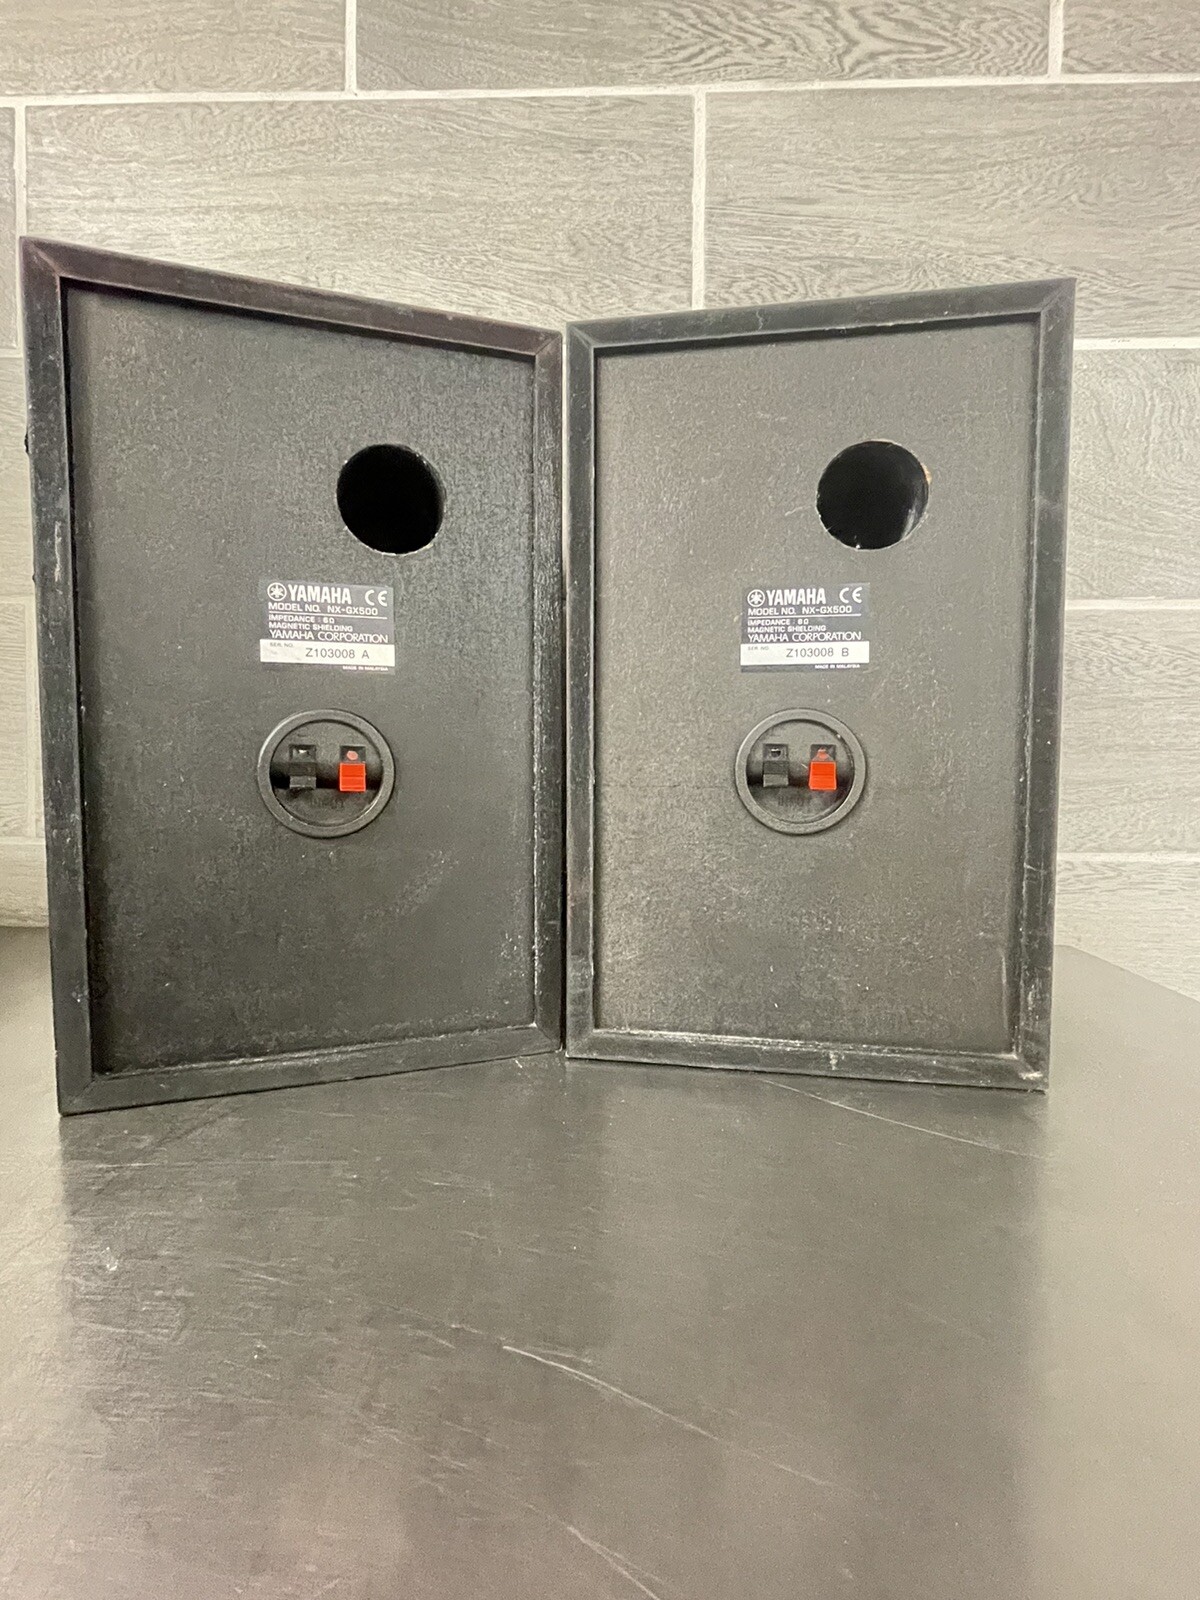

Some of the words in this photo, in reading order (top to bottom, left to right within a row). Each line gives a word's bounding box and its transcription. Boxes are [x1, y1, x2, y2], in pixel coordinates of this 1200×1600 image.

[289, 584, 351, 604] YAMAHA
[767, 588, 826, 606] YAMAHA
[268, 602, 303, 611] MODEL
[305, 604, 320, 612] NO.
[327, 605, 378, 615] NX-GX500
[748, 607, 778, 615] MODEL
[802, 606, 852, 614] NX-GX500
[269, 614, 315, 622] IMPEDANCE
[269, 622, 310, 630] MAGNETIC
[312, 624, 353, 632] SHIELDING
[269, 630, 314, 640] YAMAHA
[318, 632, 388, 643] CORPORATION
[748, 634, 788, 642] YAMAHA
[792, 632, 861, 642] CORPORATION
[305, 648, 355, 659] Z103008
[362, 650, 369, 659] A
[786, 648, 833, 658] Z103008
[842, 648, 849, 656] B
